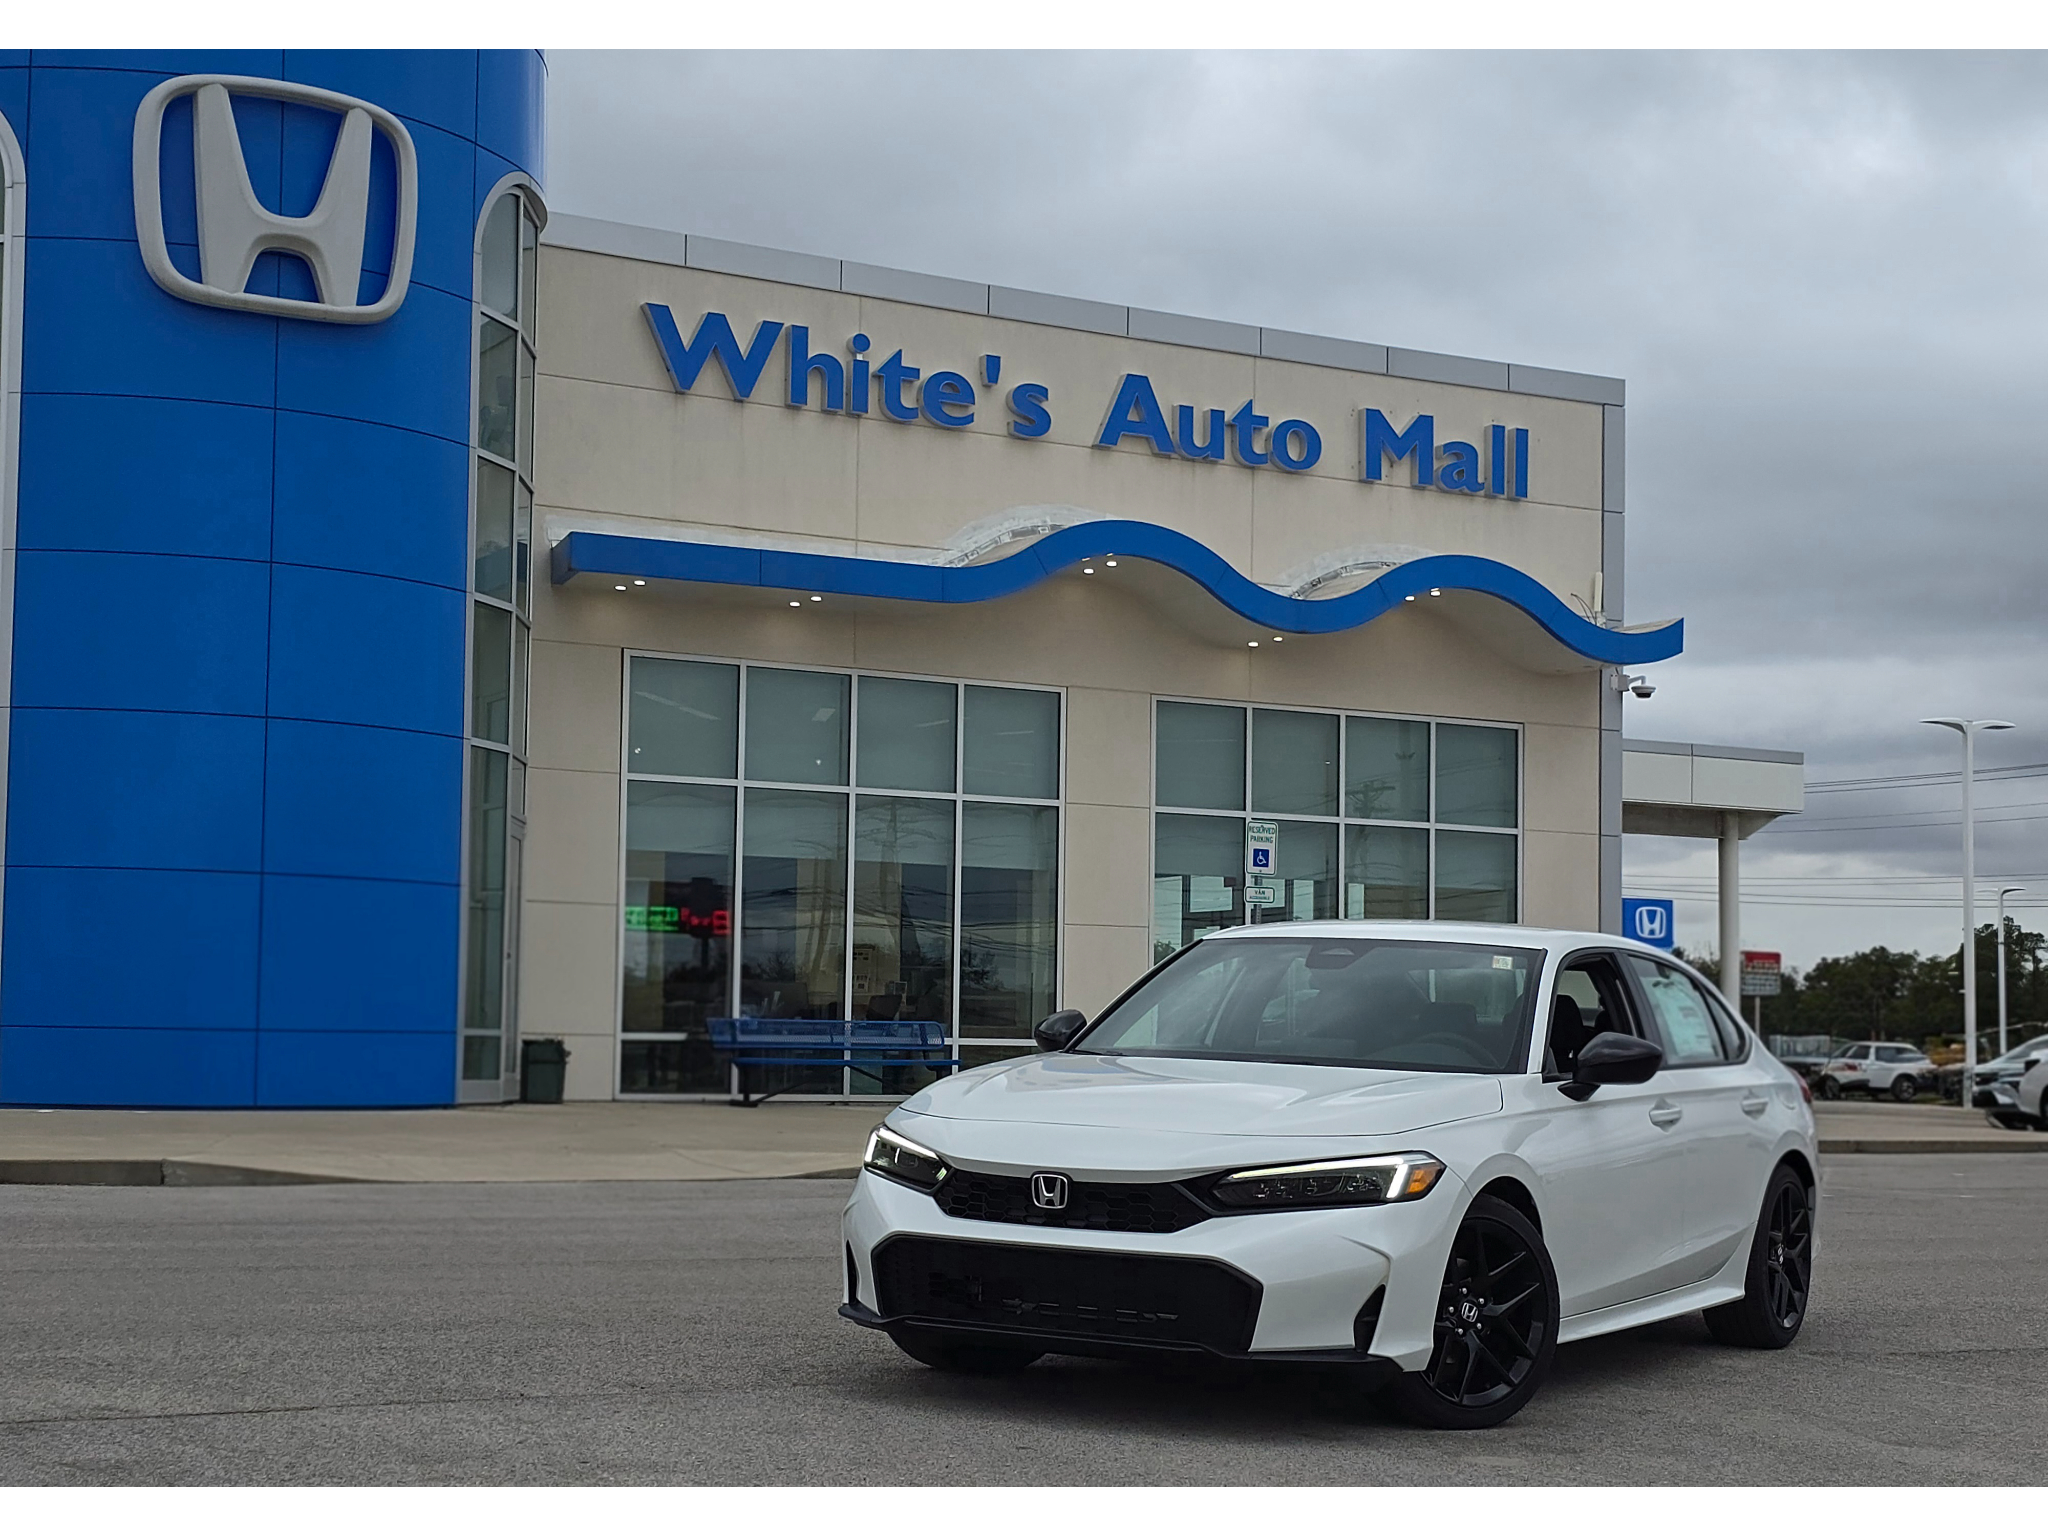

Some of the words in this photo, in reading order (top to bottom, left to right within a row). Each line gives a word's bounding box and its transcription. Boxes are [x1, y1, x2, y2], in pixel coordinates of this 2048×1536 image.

[641, 301, 1052, 440] White's
[1092, 372, 1323, 473] Auto
[1358, 407, 1529, 499] Mall
[1249, 825, 1276, 834] RESERVED
[1250, 835, 1274, 843] PARKING
